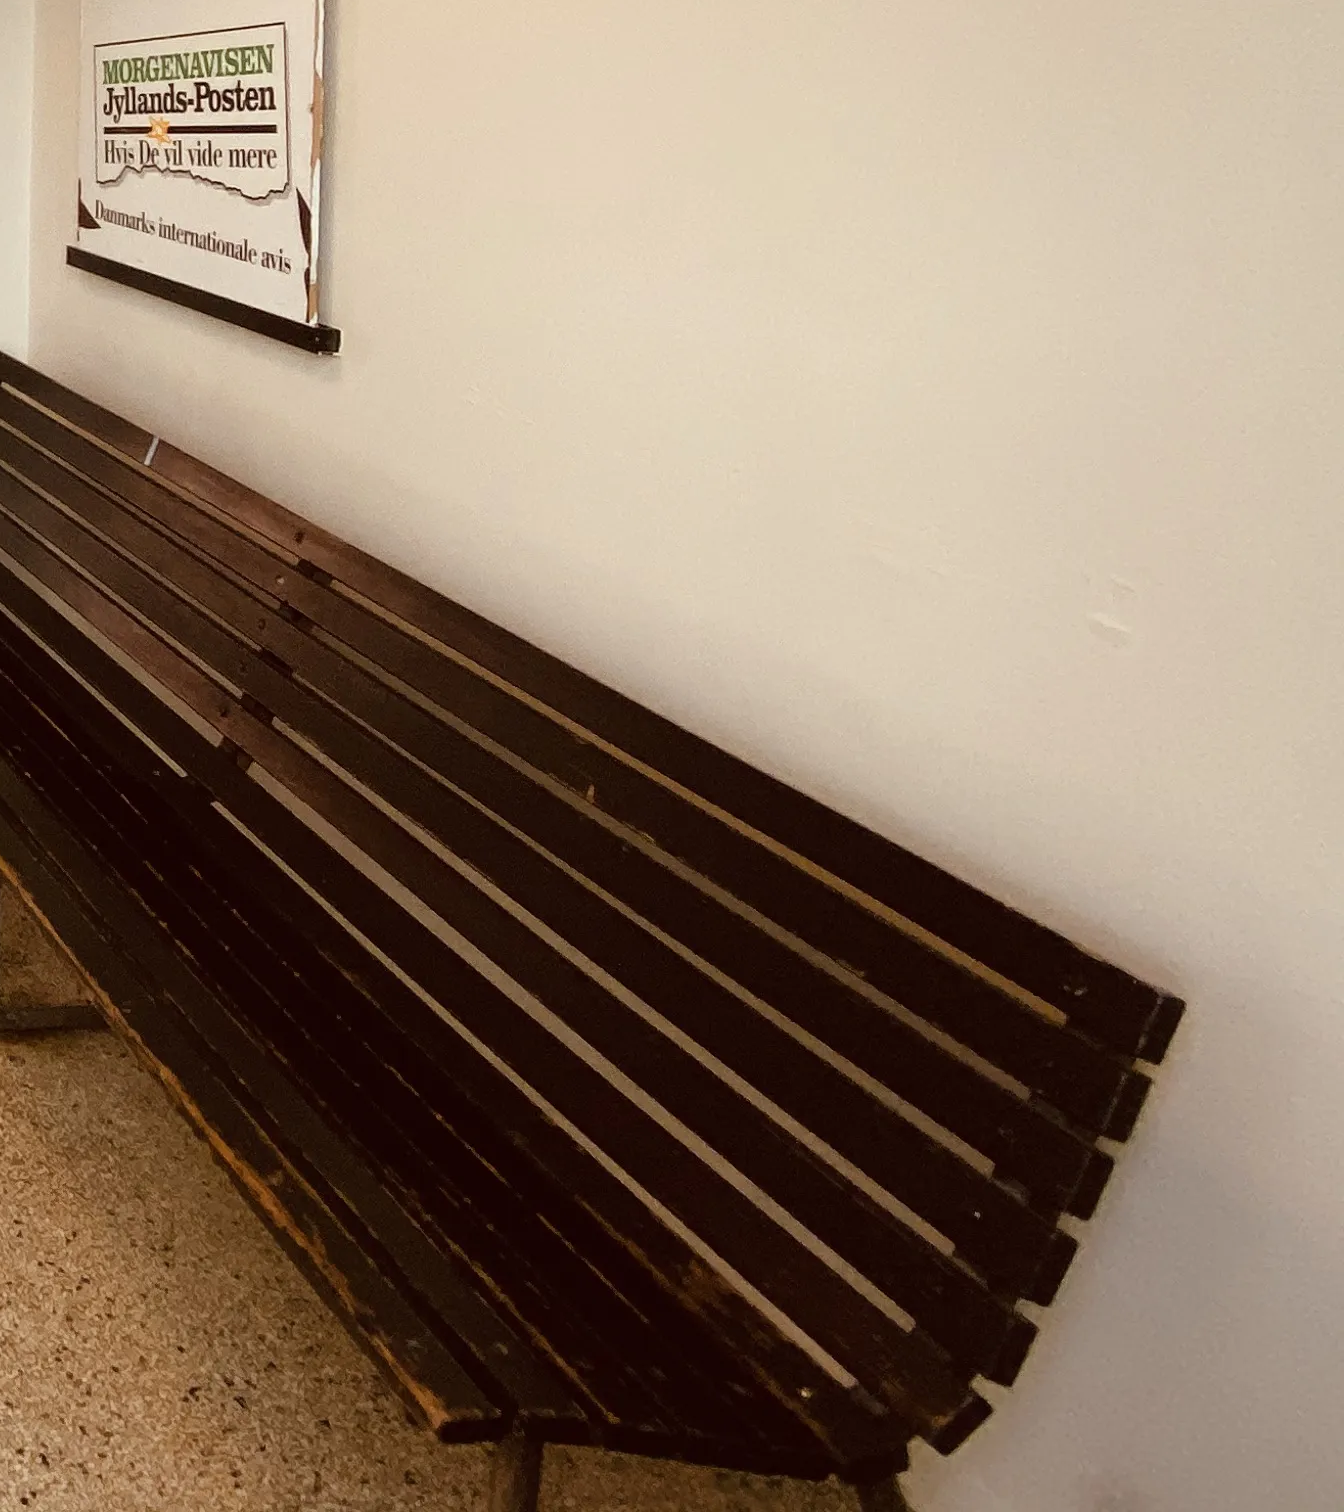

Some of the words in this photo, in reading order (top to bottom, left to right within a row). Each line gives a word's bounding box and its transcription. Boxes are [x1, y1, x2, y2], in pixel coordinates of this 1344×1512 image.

[102, 44, 275, 85] MORGENAVISEN
[103, 80, 276, 123] Jyllands-Posten
[104, 139, 135, 165] Hvis
[139, 140, 159, 166] De
[164, 139, 183, 167] vil
[188, 141, 223, 168] vide
[228, 146, 277, 169] mere
[95, 199, 155, 236] Danmarks
[158, 217, 257, 265] internationale
[261, 247, 292, 275] avis
